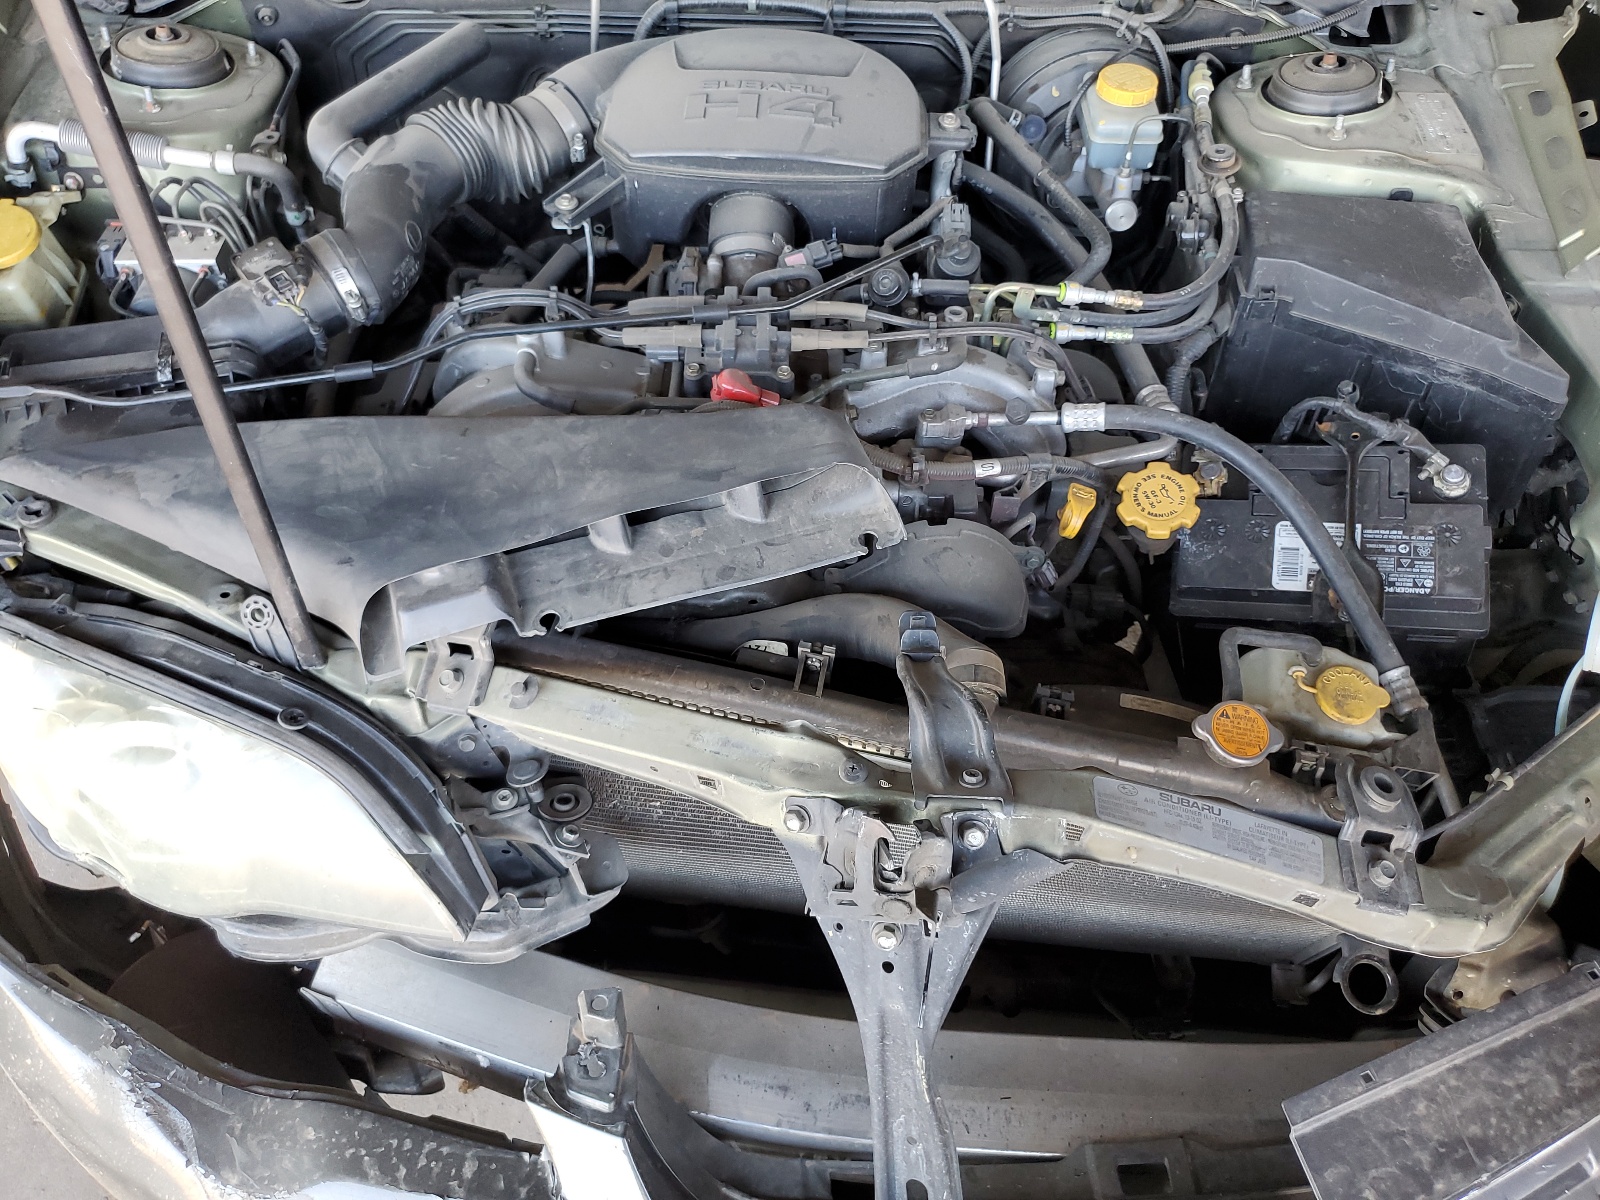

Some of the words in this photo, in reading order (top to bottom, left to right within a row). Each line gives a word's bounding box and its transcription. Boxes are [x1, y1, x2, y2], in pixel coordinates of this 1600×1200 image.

[700, 79, 830, 97] SUBARU
[684, 92, 842, 129] H4
[1141, 473, 1157, 482] SEE
[1132, 482, 1147, 513] OWNER'S
[1160, 473, 1186, 493] ENGINE
[1177, 495, 1187, 506] OIL
[1146, 509, 1179, 518] MANUAL
[1322, 668, 1373, 687] COOLANT
[1143, 797, 1156, 805] AIR
[1157, 800, 1202, 817] CONDITIONER
[1159, 792, 1222, 817] SUBARU
[1248, 826, 1285, 841] CLIMATISEUR
